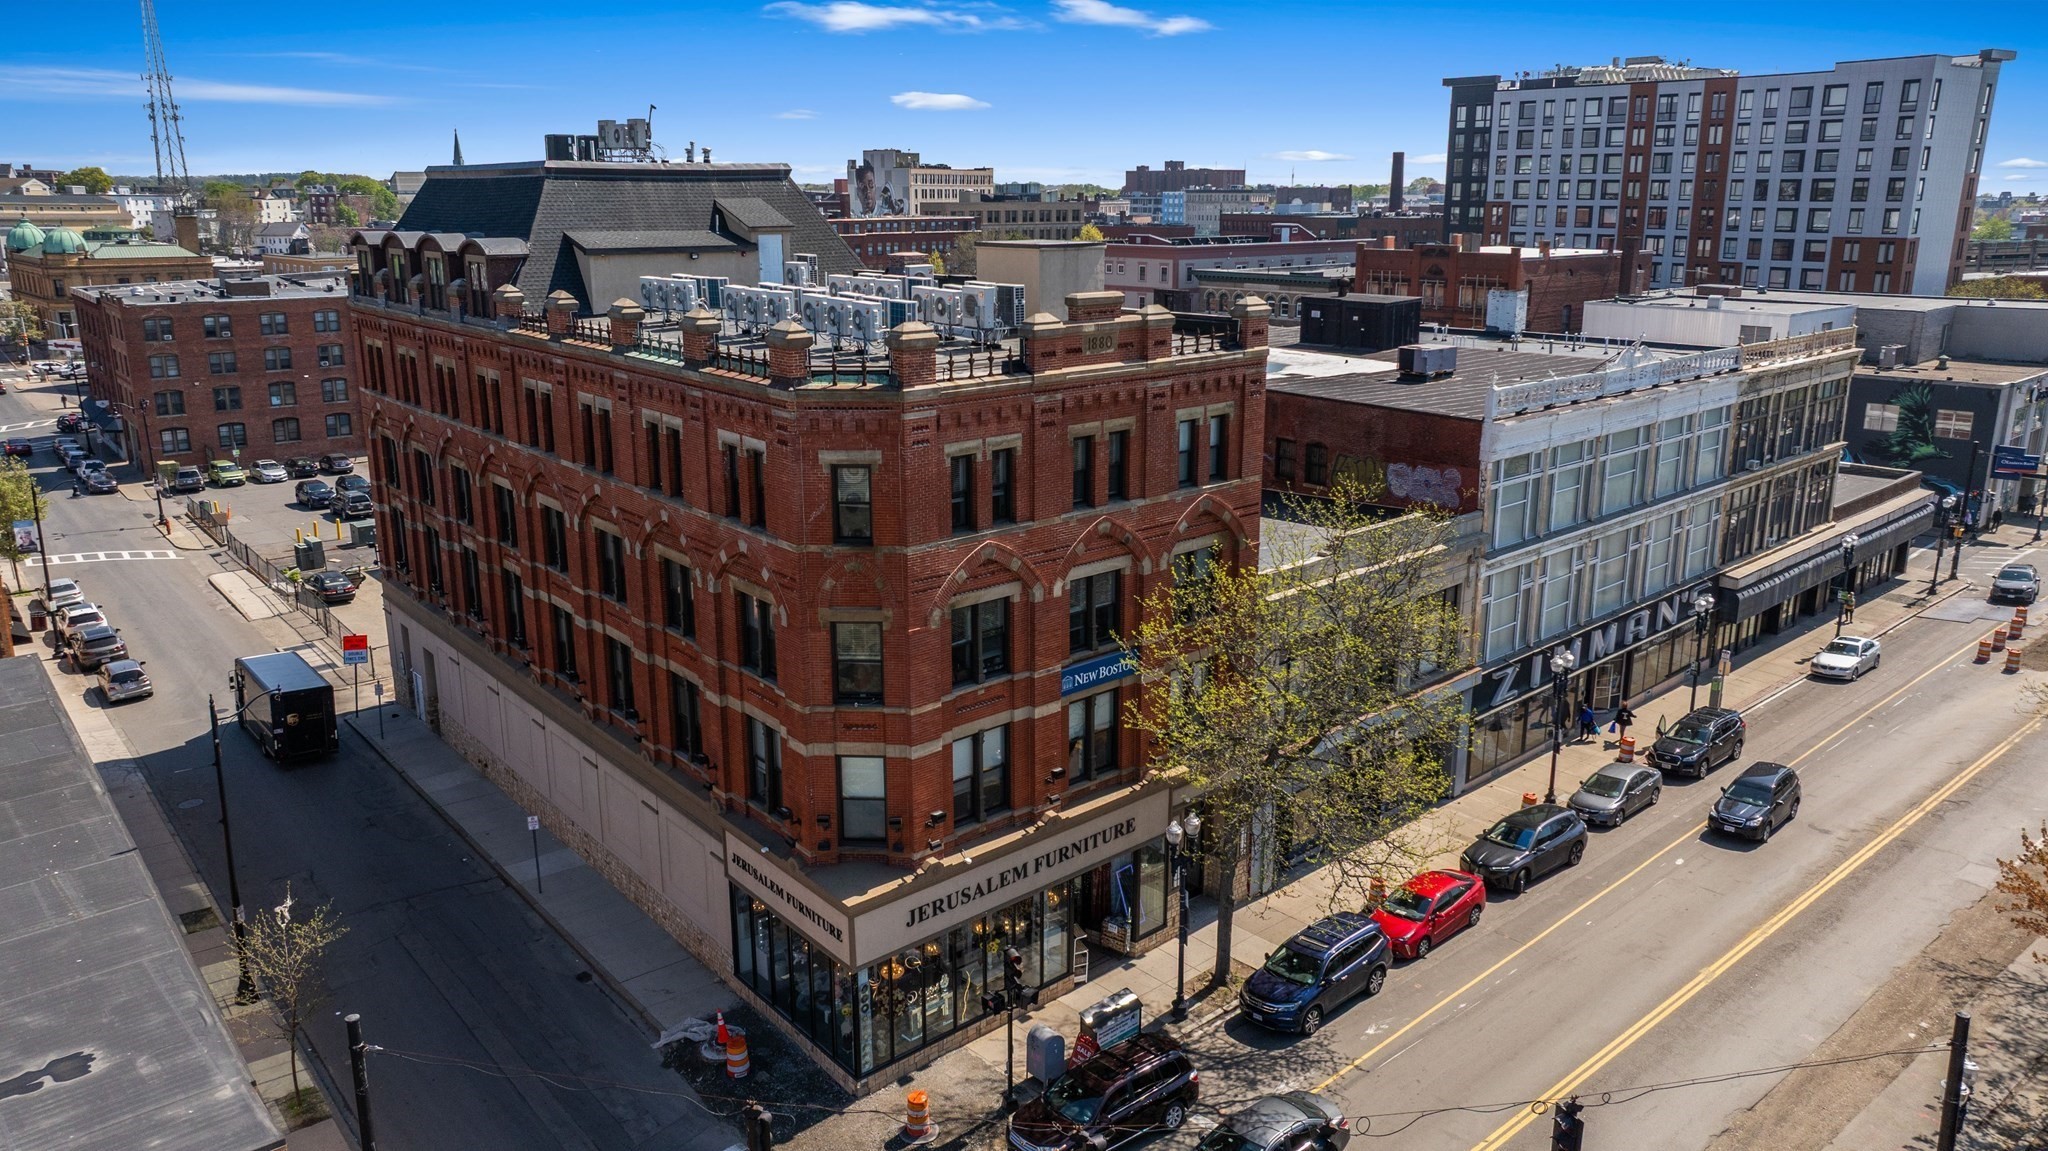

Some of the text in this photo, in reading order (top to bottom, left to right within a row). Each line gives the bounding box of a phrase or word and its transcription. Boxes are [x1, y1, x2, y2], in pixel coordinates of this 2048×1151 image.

[1088, 335, 1113, 350] 1880
[1074, 669, 1098, 687] NEW
[905, 817, 1137, 928] JERUSALEM FURNITURE
[731, 852, 843, 943] JERUSALEM FURNITURE
[1076, 1045, 1092, 1057] SALE
